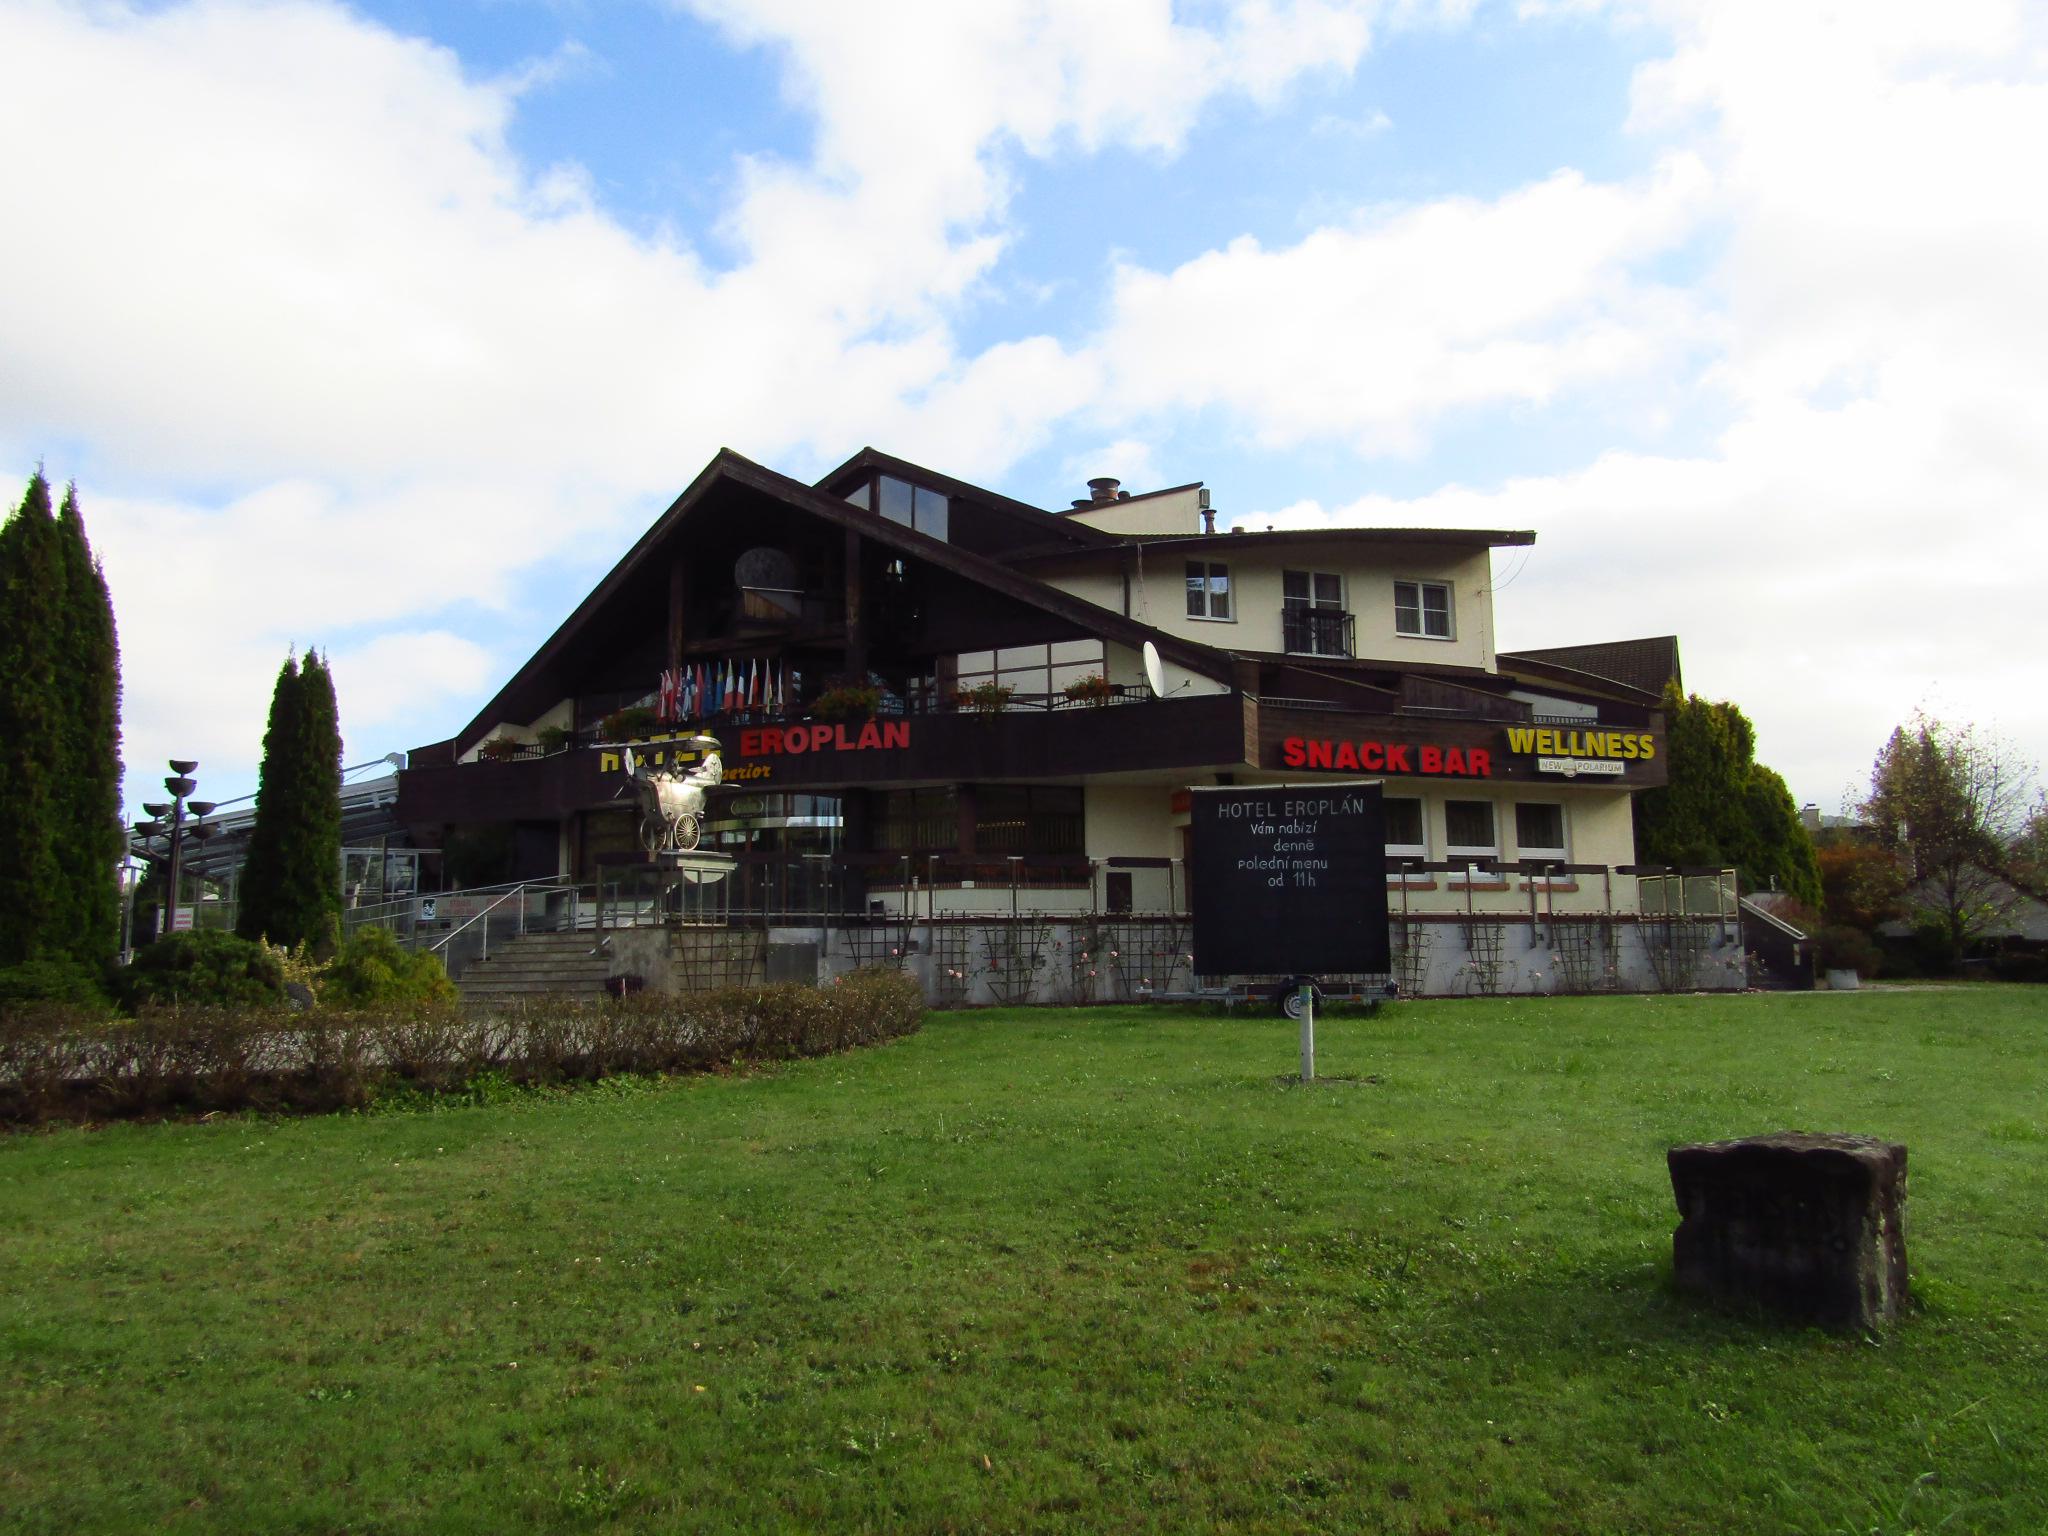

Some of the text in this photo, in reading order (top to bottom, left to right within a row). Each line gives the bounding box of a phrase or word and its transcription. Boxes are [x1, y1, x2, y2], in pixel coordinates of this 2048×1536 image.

[740, 716, 911, 757] EROPLÁN
[1507, 727, 1656, 760] WELLNESS
[1283, 736, 1491, 776] SNACK BAR
[1542, 760, 1561, 770] NEW
[1218, 794, 1364, 818] HOTEL EROPLÁN
[1273, 838, 1315, 851] denně
[1292, 859, 1328, 869] menu
[1267, 873, 1284, 887] od
